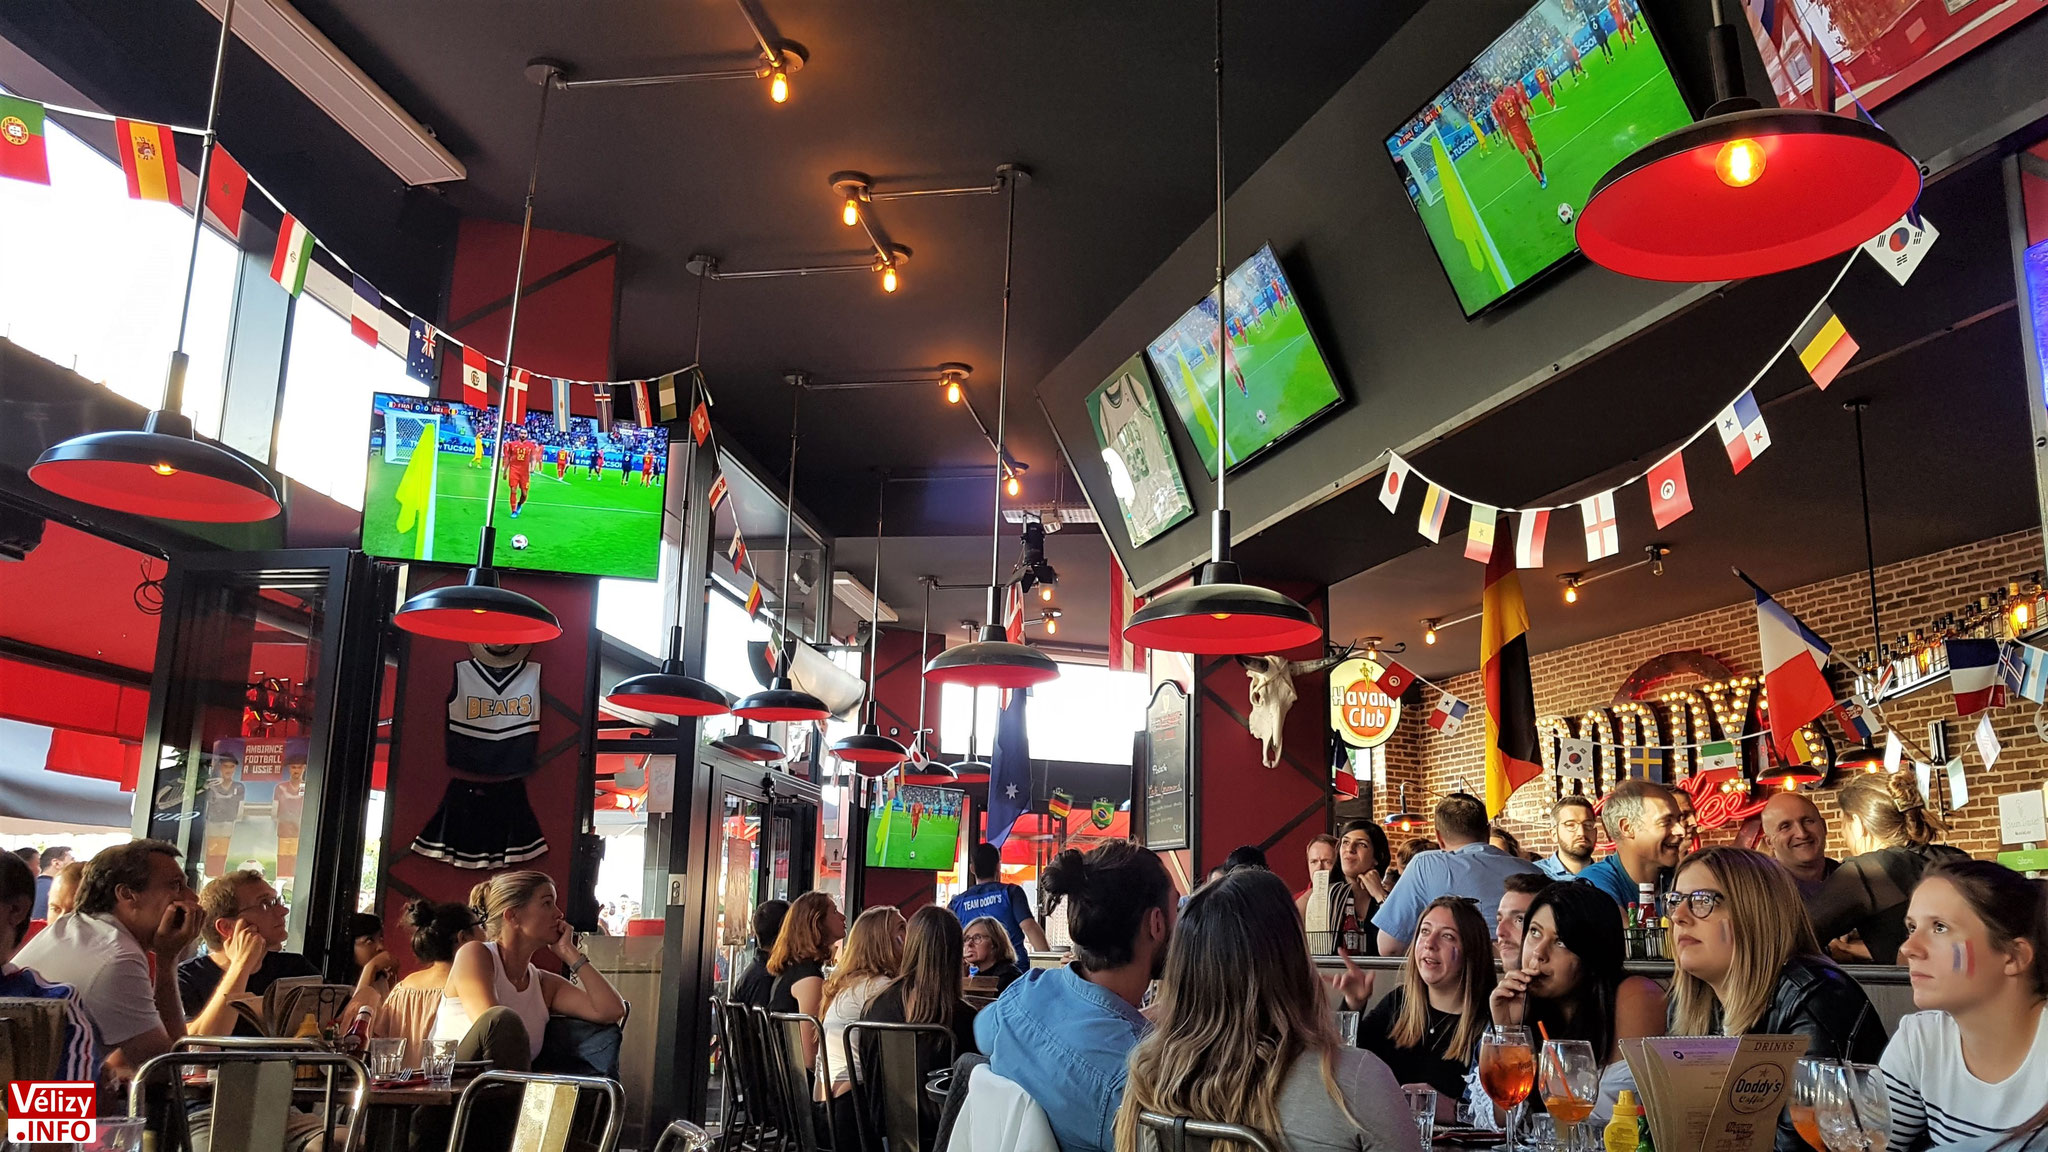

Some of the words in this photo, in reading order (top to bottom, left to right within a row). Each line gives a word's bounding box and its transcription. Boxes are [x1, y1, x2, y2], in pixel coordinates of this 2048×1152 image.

[1453, 134, 1478, 156] TUCSON
[443, 443, 475, 454] TUCSON
[466, 693, 532, 720] BEARS
[1348, 707, 1386, 728] Club
[245, 744, 284, 754] AMBIANCE
[244, 754, 282, 764] FOOTBALL
[963, 898, 979, 911] TEAM
[980, 894, 1002, 908] DODDY'S
[1753, 1041, 1795, 1052] DRINKS
[1735, 1078, 1782, 1097] Doddy's
